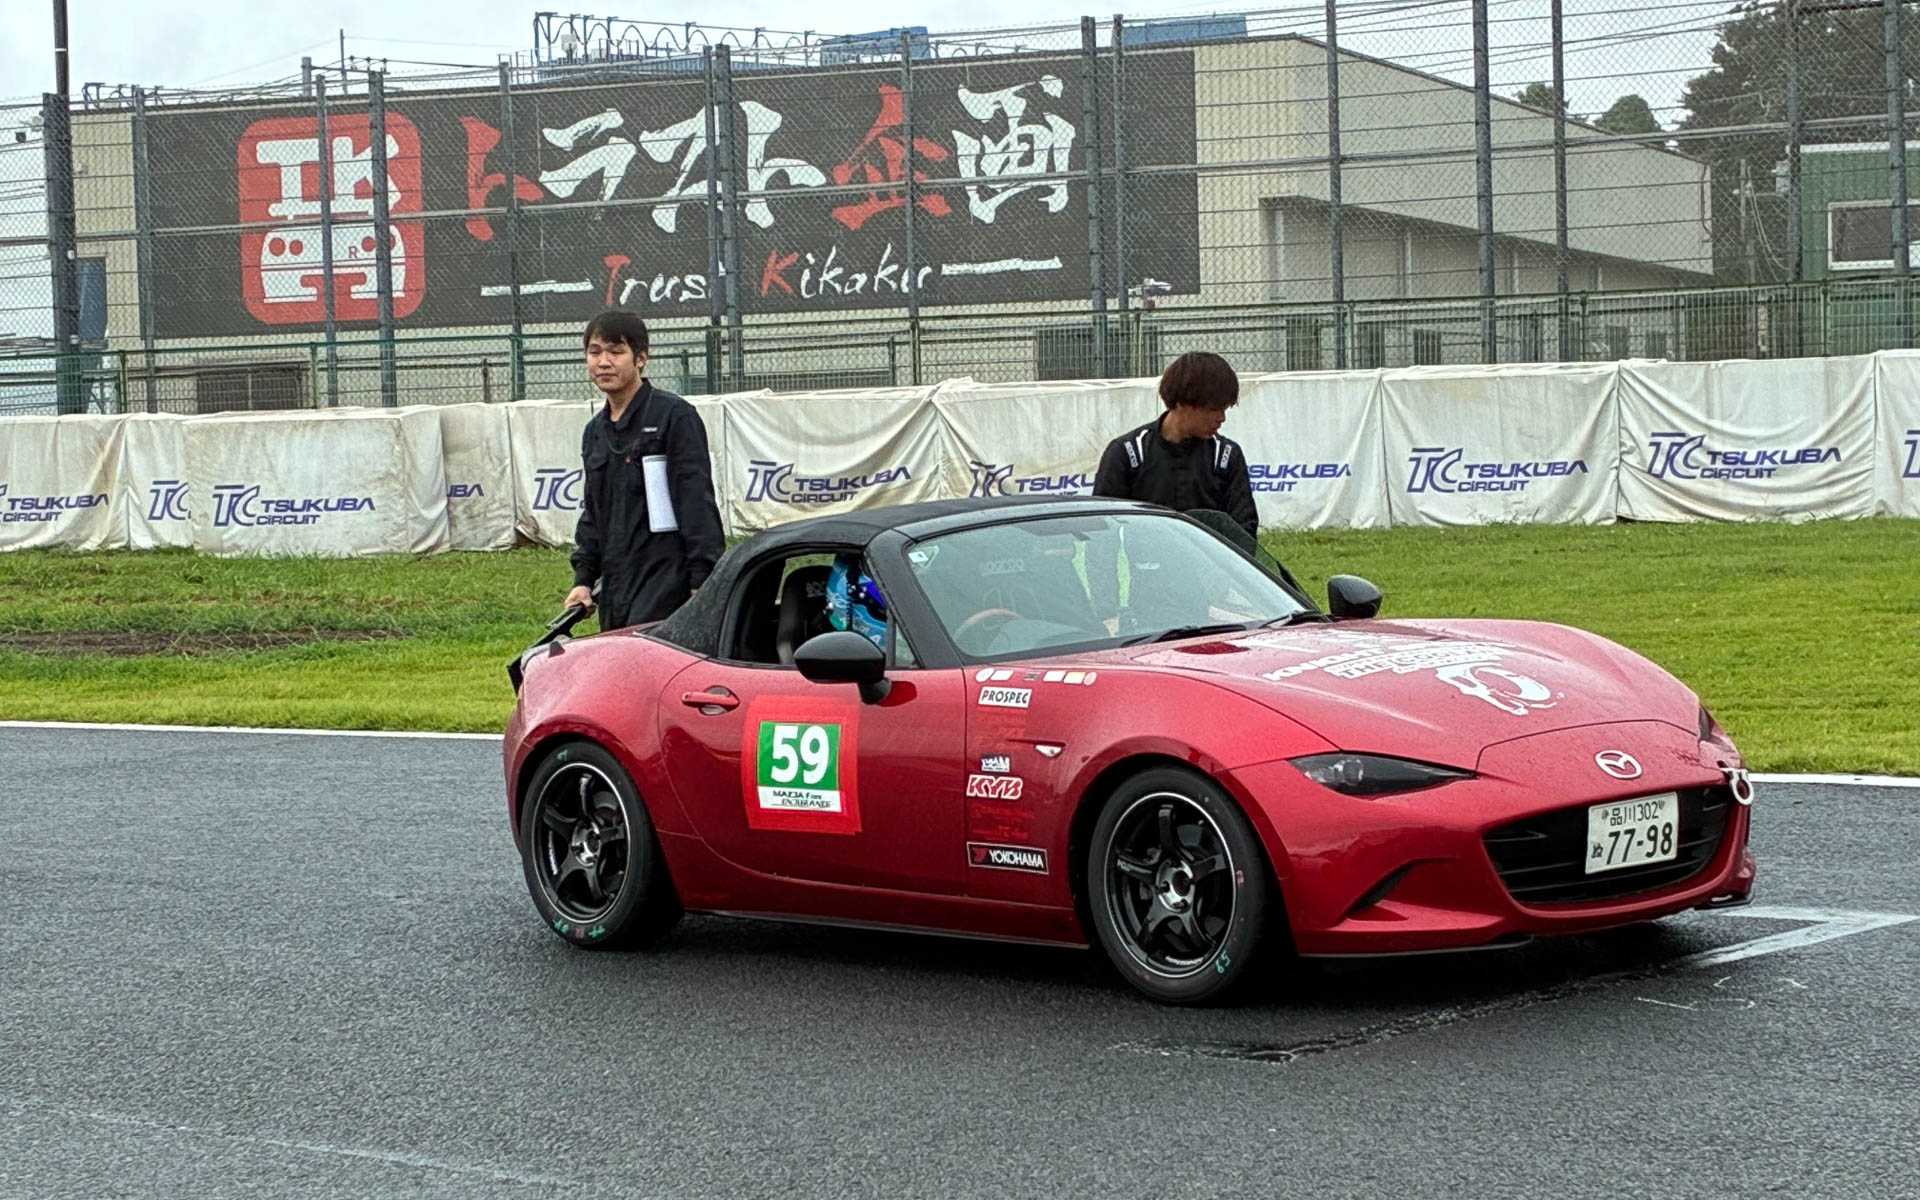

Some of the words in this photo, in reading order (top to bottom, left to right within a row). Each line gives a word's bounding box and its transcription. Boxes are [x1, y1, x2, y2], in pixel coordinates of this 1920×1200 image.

[462, 74, 1076, 241] トラスト企画
[761, 242, 933, 299] Kikaku
[1706, 447, 1842, 466] TSUKUBA
[794, 466, 912, 492] TSUKUBA
[1247, 463, 1352, 479] SUKUBA
[1463, 459, 1589, 479] TSUKUBA
[7, 493, 110, 511] TSUKUBA
[260, 498, 376, 513] TSUKUBA
[981, 689, 1029, 705] PROSPEC
[770, 725, 830, 785] 59
[966, 774, 1024, 800] KYB
[1606, 821, 1673, 865] 77-98
[988, 849, 1045, 869] YOKOHAMA
